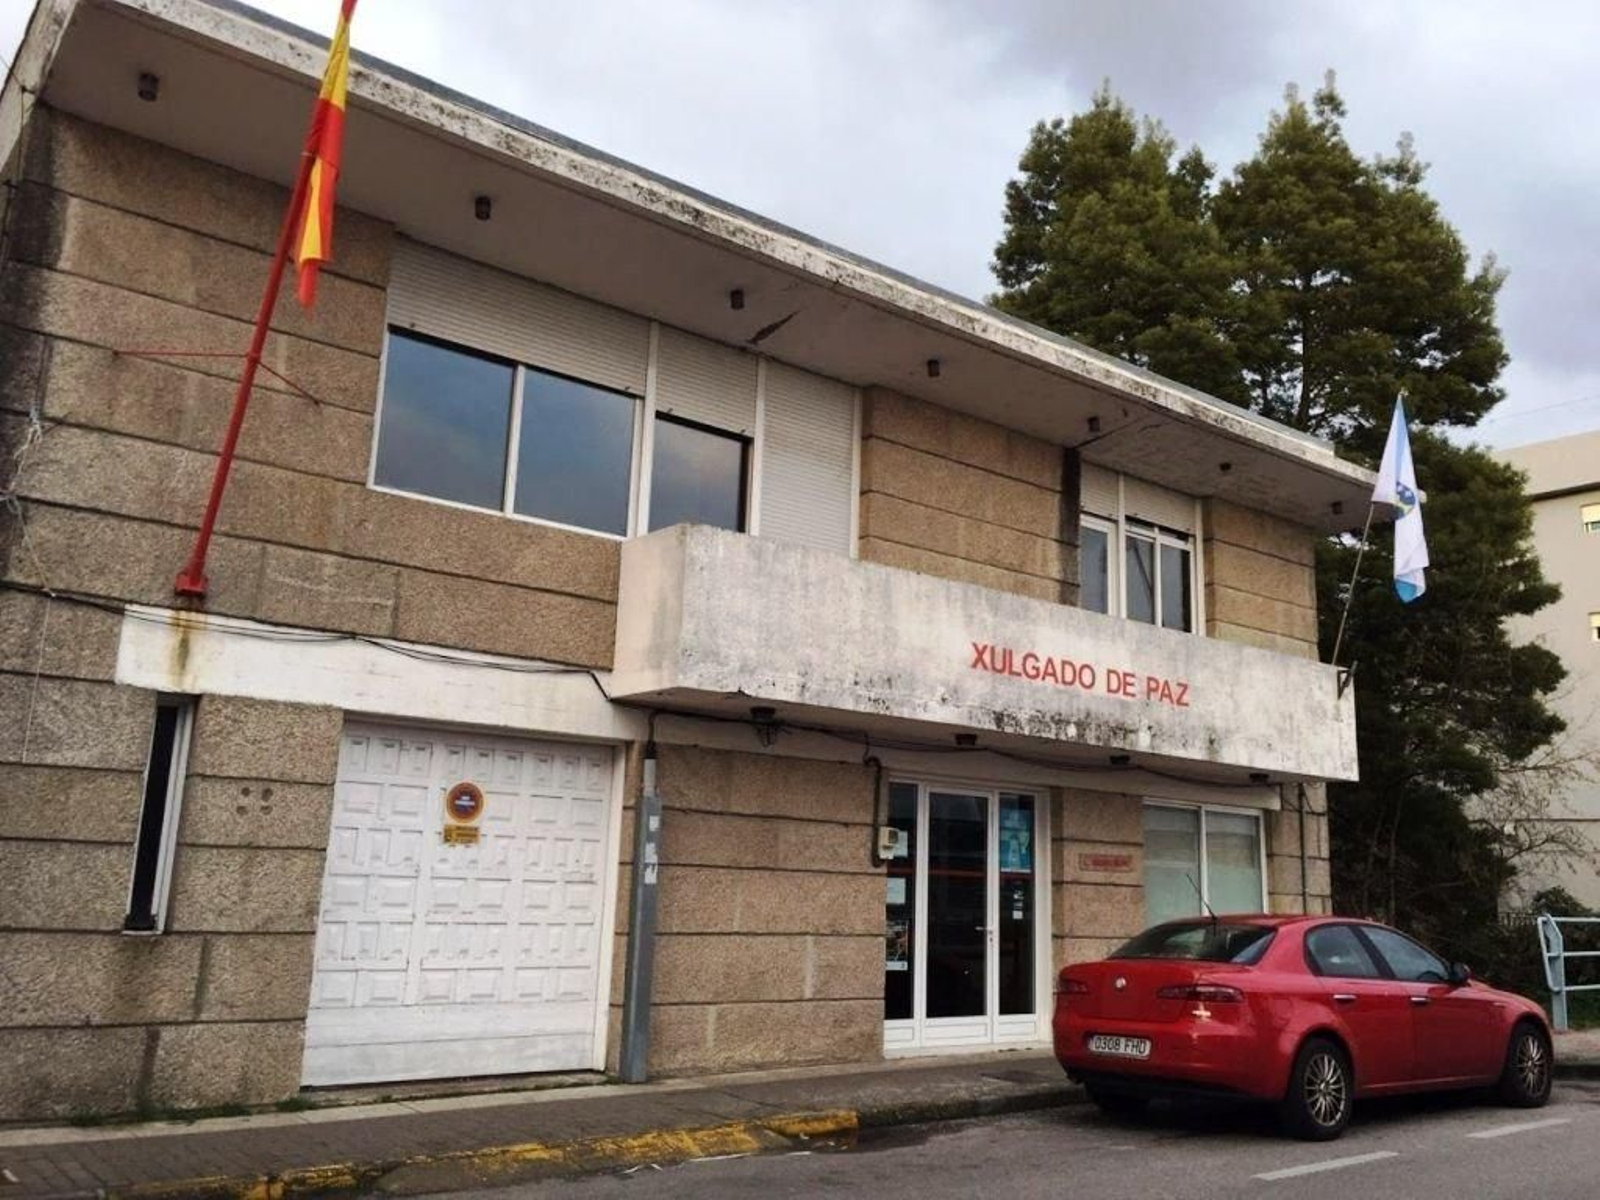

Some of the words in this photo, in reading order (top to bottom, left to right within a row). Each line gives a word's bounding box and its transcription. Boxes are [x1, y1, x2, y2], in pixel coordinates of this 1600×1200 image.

[971, 642, 1096, 690] XULGADO
[1106, 669, 1136, 697] DE
[1146, 676, 1190, 707] PAZ
